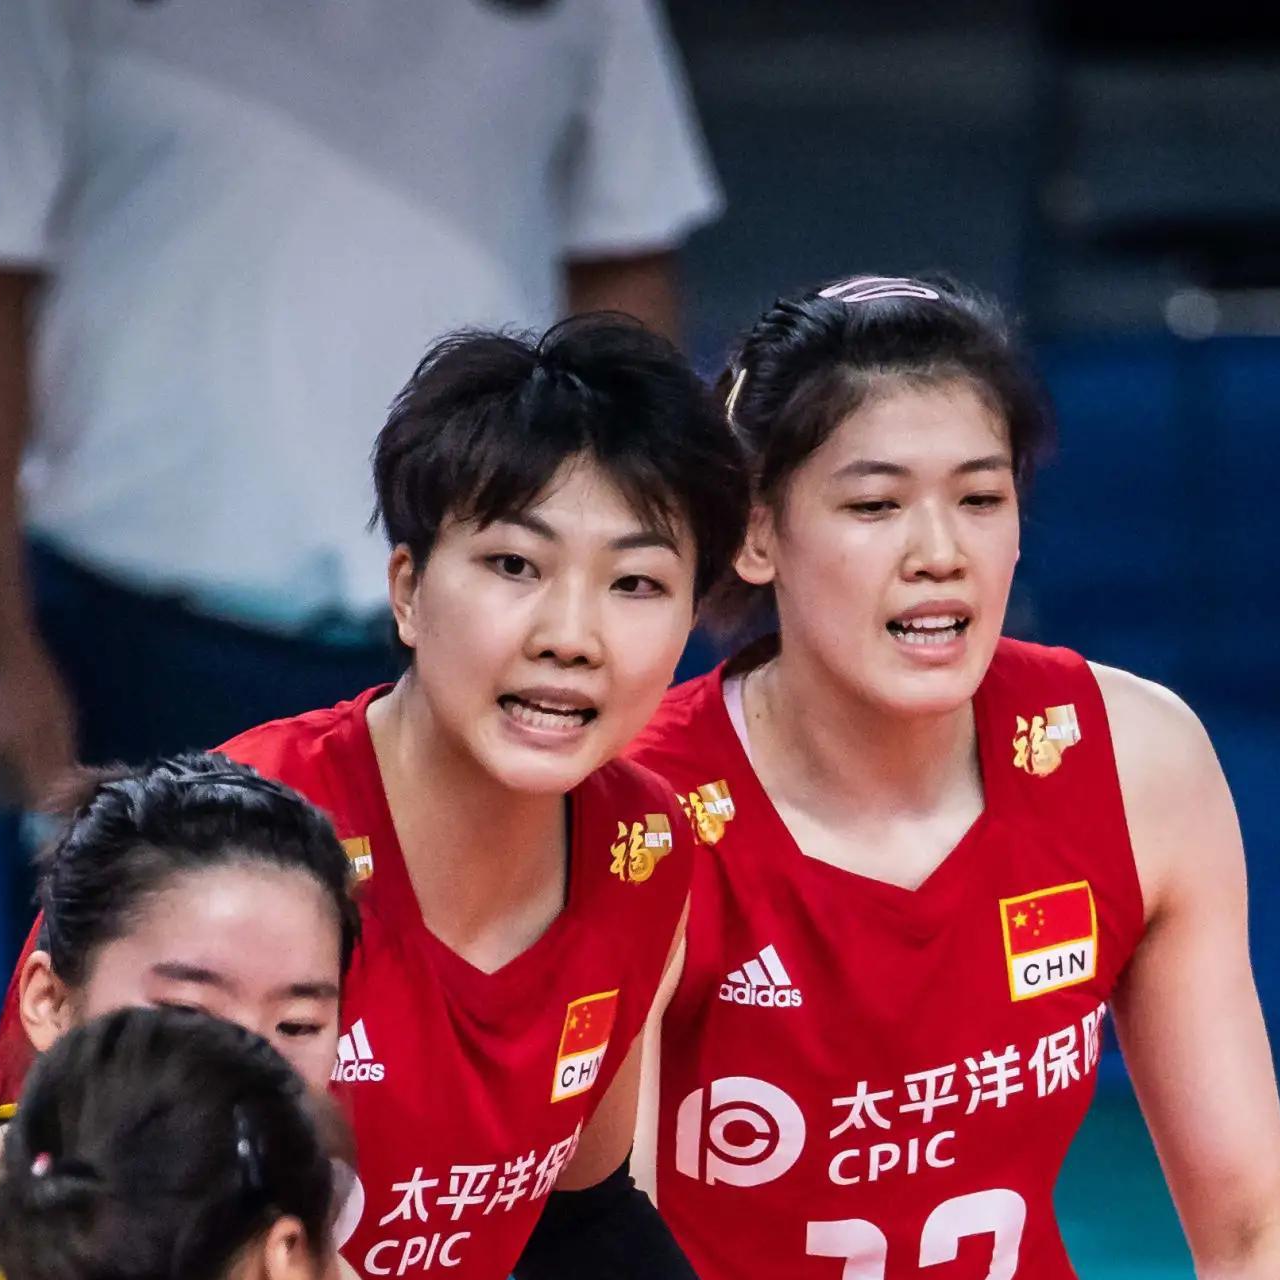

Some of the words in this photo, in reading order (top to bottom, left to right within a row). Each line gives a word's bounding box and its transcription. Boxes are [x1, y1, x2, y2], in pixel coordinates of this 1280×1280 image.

[1023, 949, 1086, 986] CHN
[719, 983, 803, 1008] adidas
[828, 1130, 957, 1186] CPIC
[363, 1231, 472, 1276] CPIC
